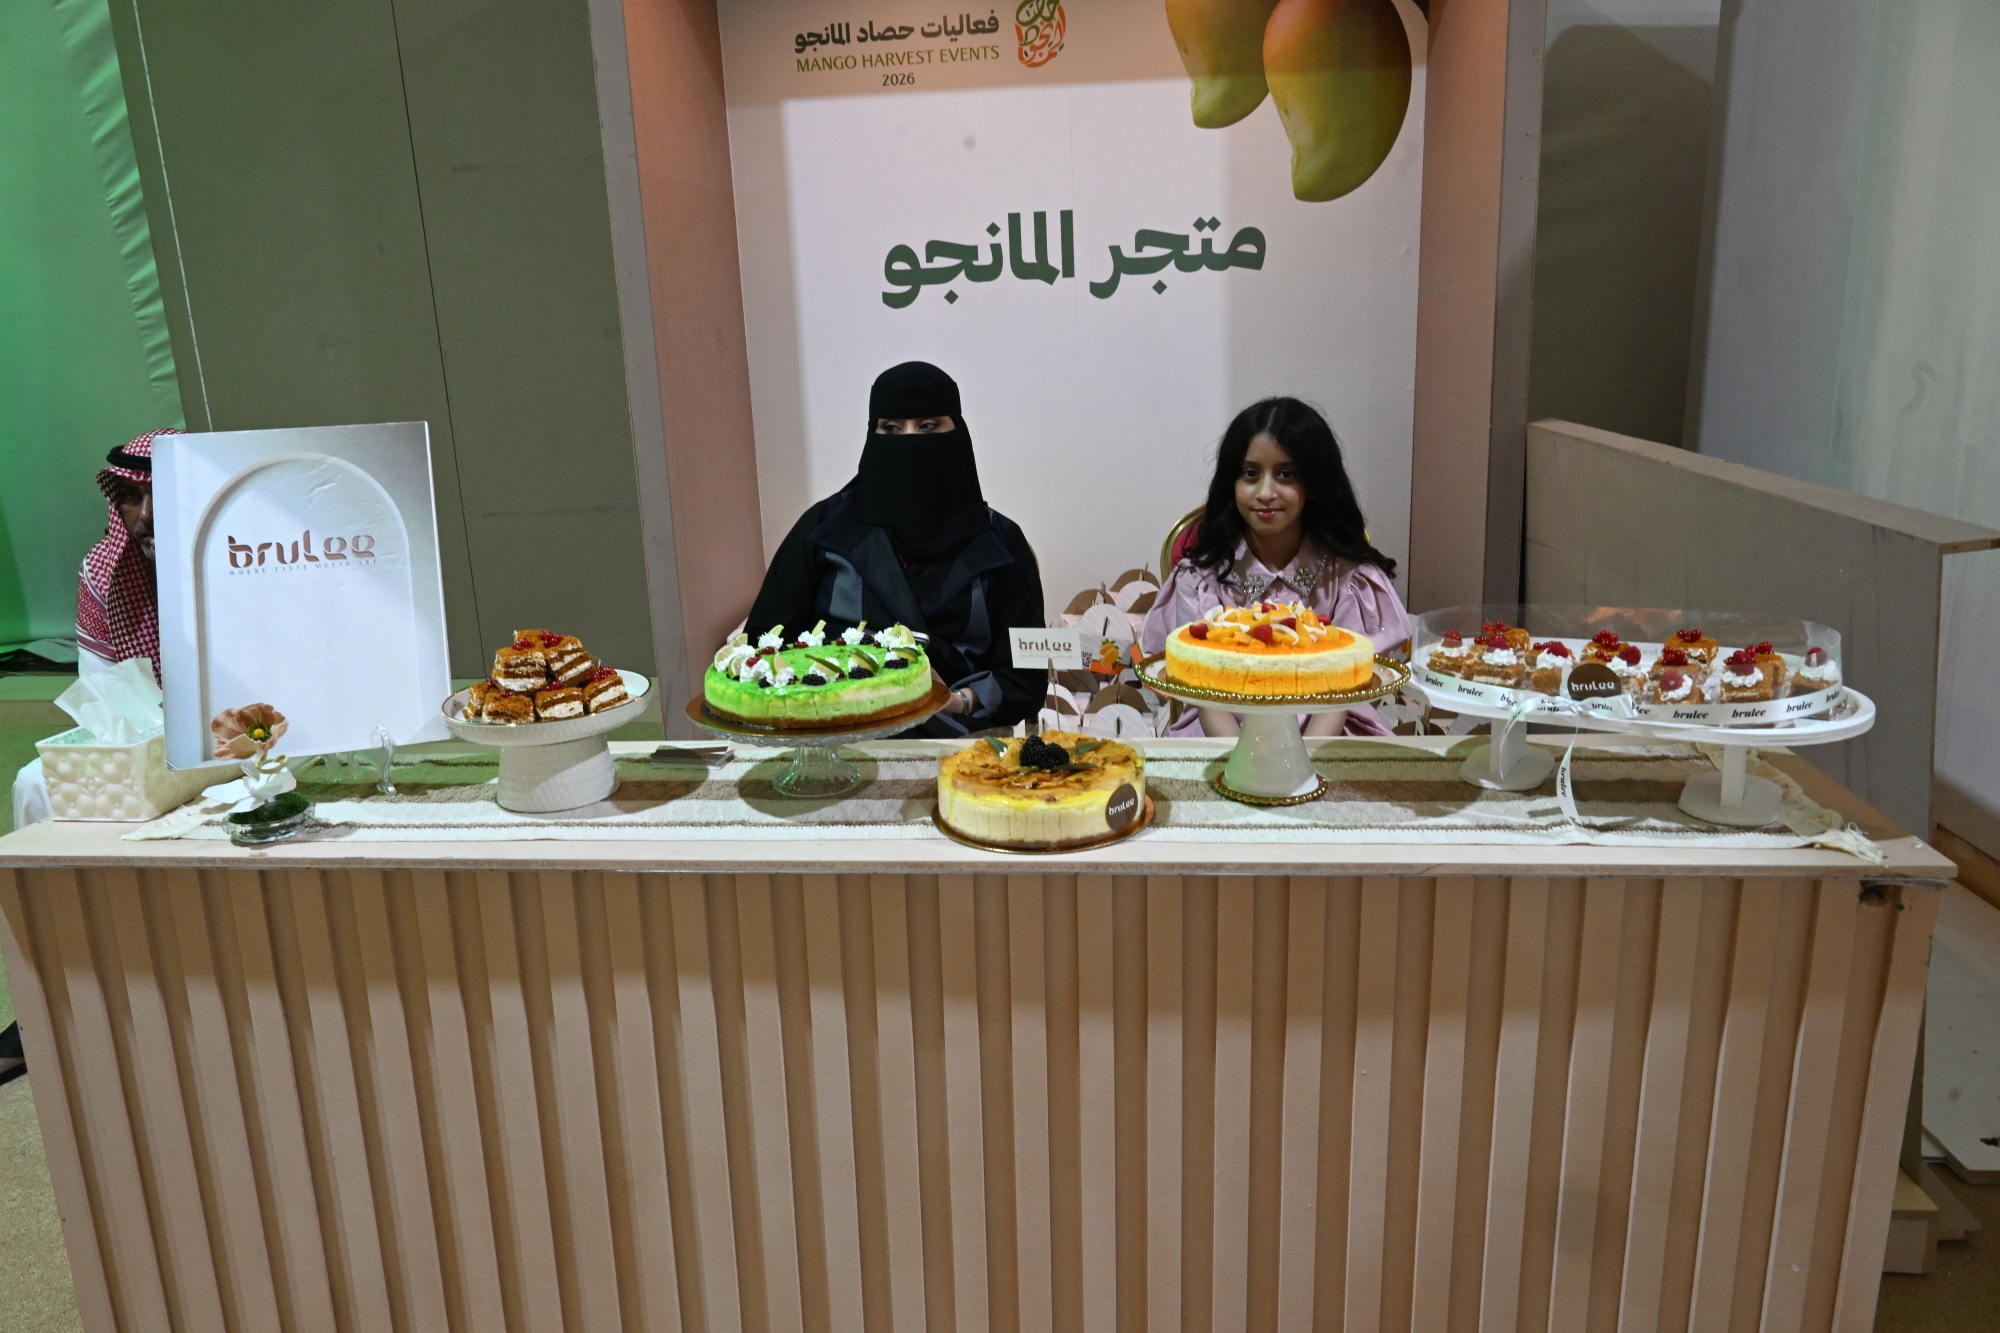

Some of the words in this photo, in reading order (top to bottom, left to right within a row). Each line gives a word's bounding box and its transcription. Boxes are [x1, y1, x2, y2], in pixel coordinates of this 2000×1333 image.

[856, 20, 915, 44] حصاد
[920, 9, 1000, 43] فعاليات
[794, 22, 851, 54] المانجو
[796, 55, 857, 72] MANGO
[862, 50, 934, 69] HARVEST
[940, 45, 1000, 64] EVENTS
[882, 73, 916, 86] 2026
[882, 209, 1075, 309] المانجو
[1089, 216, 1267, 299] متجر
[227, 529, 376, 569] brulee
[229, 567, 267, 576] WHERE
[1018, 638, 1072, 651] brulee
[1425, 675, 1444, 688] brulee
[1571, 681, 1615, 691] brulee
[1457, 685, 1484, 697] brulee
[1731, 708, 1766, 718] brulee
[1786, 701, 1813, 713] brulee
[1673, 710, 1709, 719] brulee
